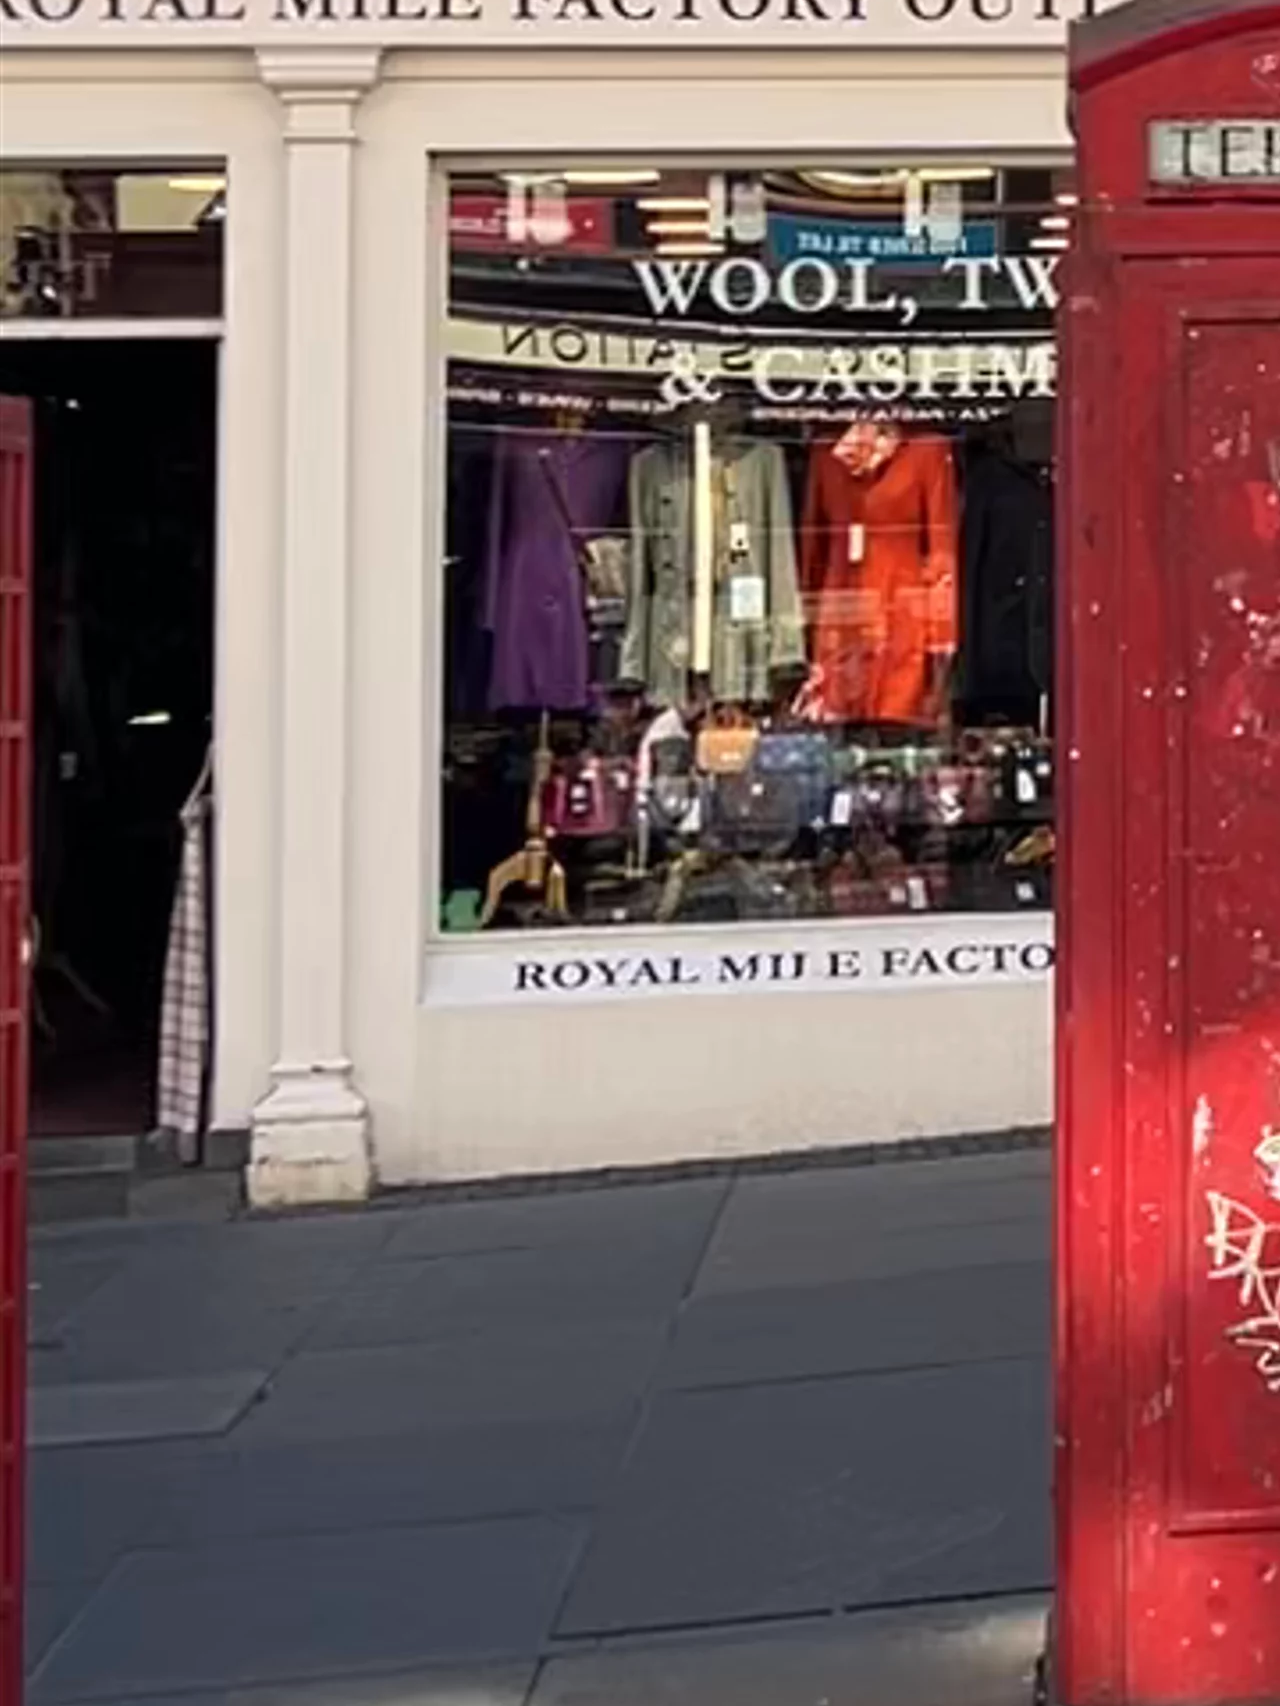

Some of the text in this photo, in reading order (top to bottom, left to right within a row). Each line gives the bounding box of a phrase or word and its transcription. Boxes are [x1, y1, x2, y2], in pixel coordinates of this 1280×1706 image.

[631, 256, 919, 325] WOOL,
[660, 350, 723, 403] &
[514, 956, 701, 992] ROYAL
[718, 948, 861, 984] MILE
